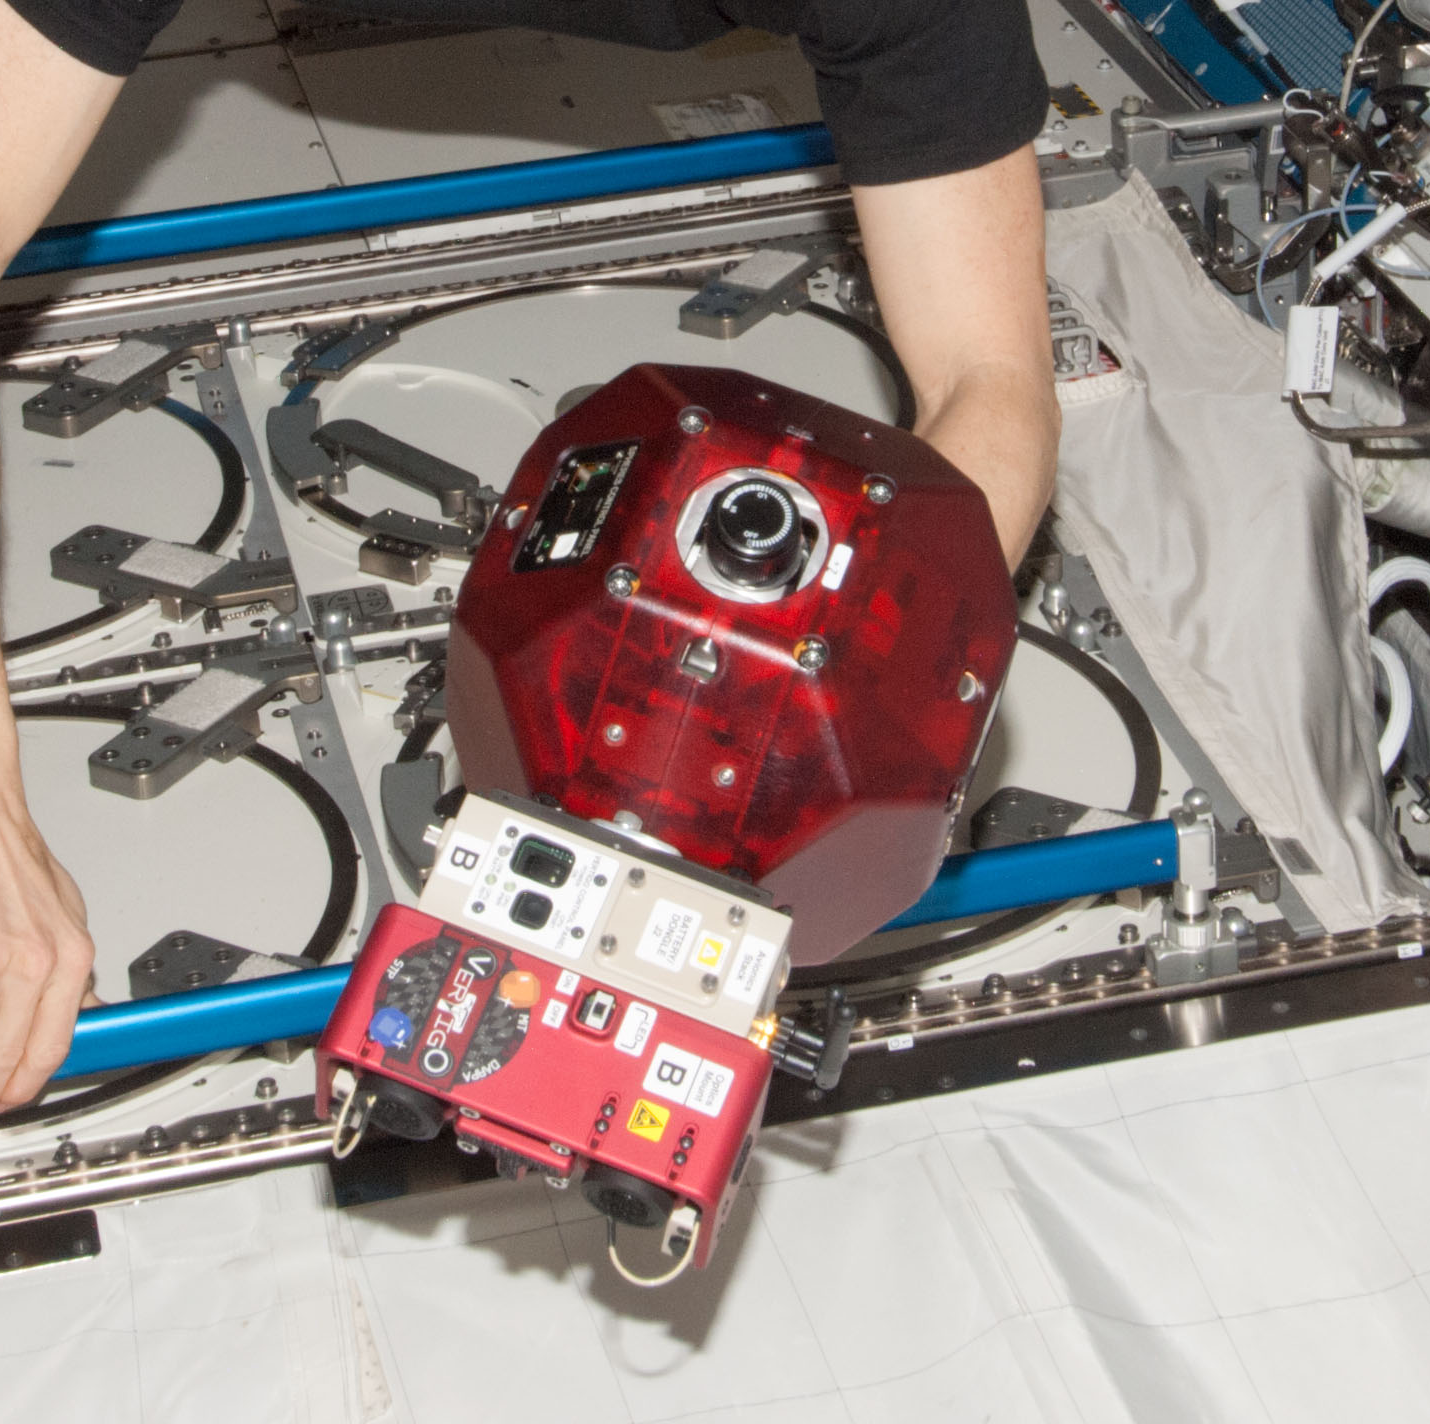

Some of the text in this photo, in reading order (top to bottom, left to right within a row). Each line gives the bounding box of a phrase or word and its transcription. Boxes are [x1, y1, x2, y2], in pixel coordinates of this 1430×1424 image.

[579, 444, 638, 558] SPHERES CONTROL PANEL
[450, 846, 480, 871] B
[554, 853, 602, 951] VERTIGO CONTROL PANEL
[651, 924, 663, 938] J2
[656, 912, 681, 956] DONGLE
[665, 914, 693, 965] BATTERY/
[385, 959, 405, 982] STP
[736, 954, 754, 981] Stack
[743, 950, 766, 993] Avionics
[563, 976, 573, 991] ON
[517, 1014, 529, 1034] MIT
[550, 1005, 562, 1023] OFF
[636, 1022, 649, 1046] LED
[461, 1058, 501, 1083] DARPA
[657, 1060, 688, 1088] B
[693, 1069, 715, 1103] Mount
[703, 1072, 725, 1107] Optics
